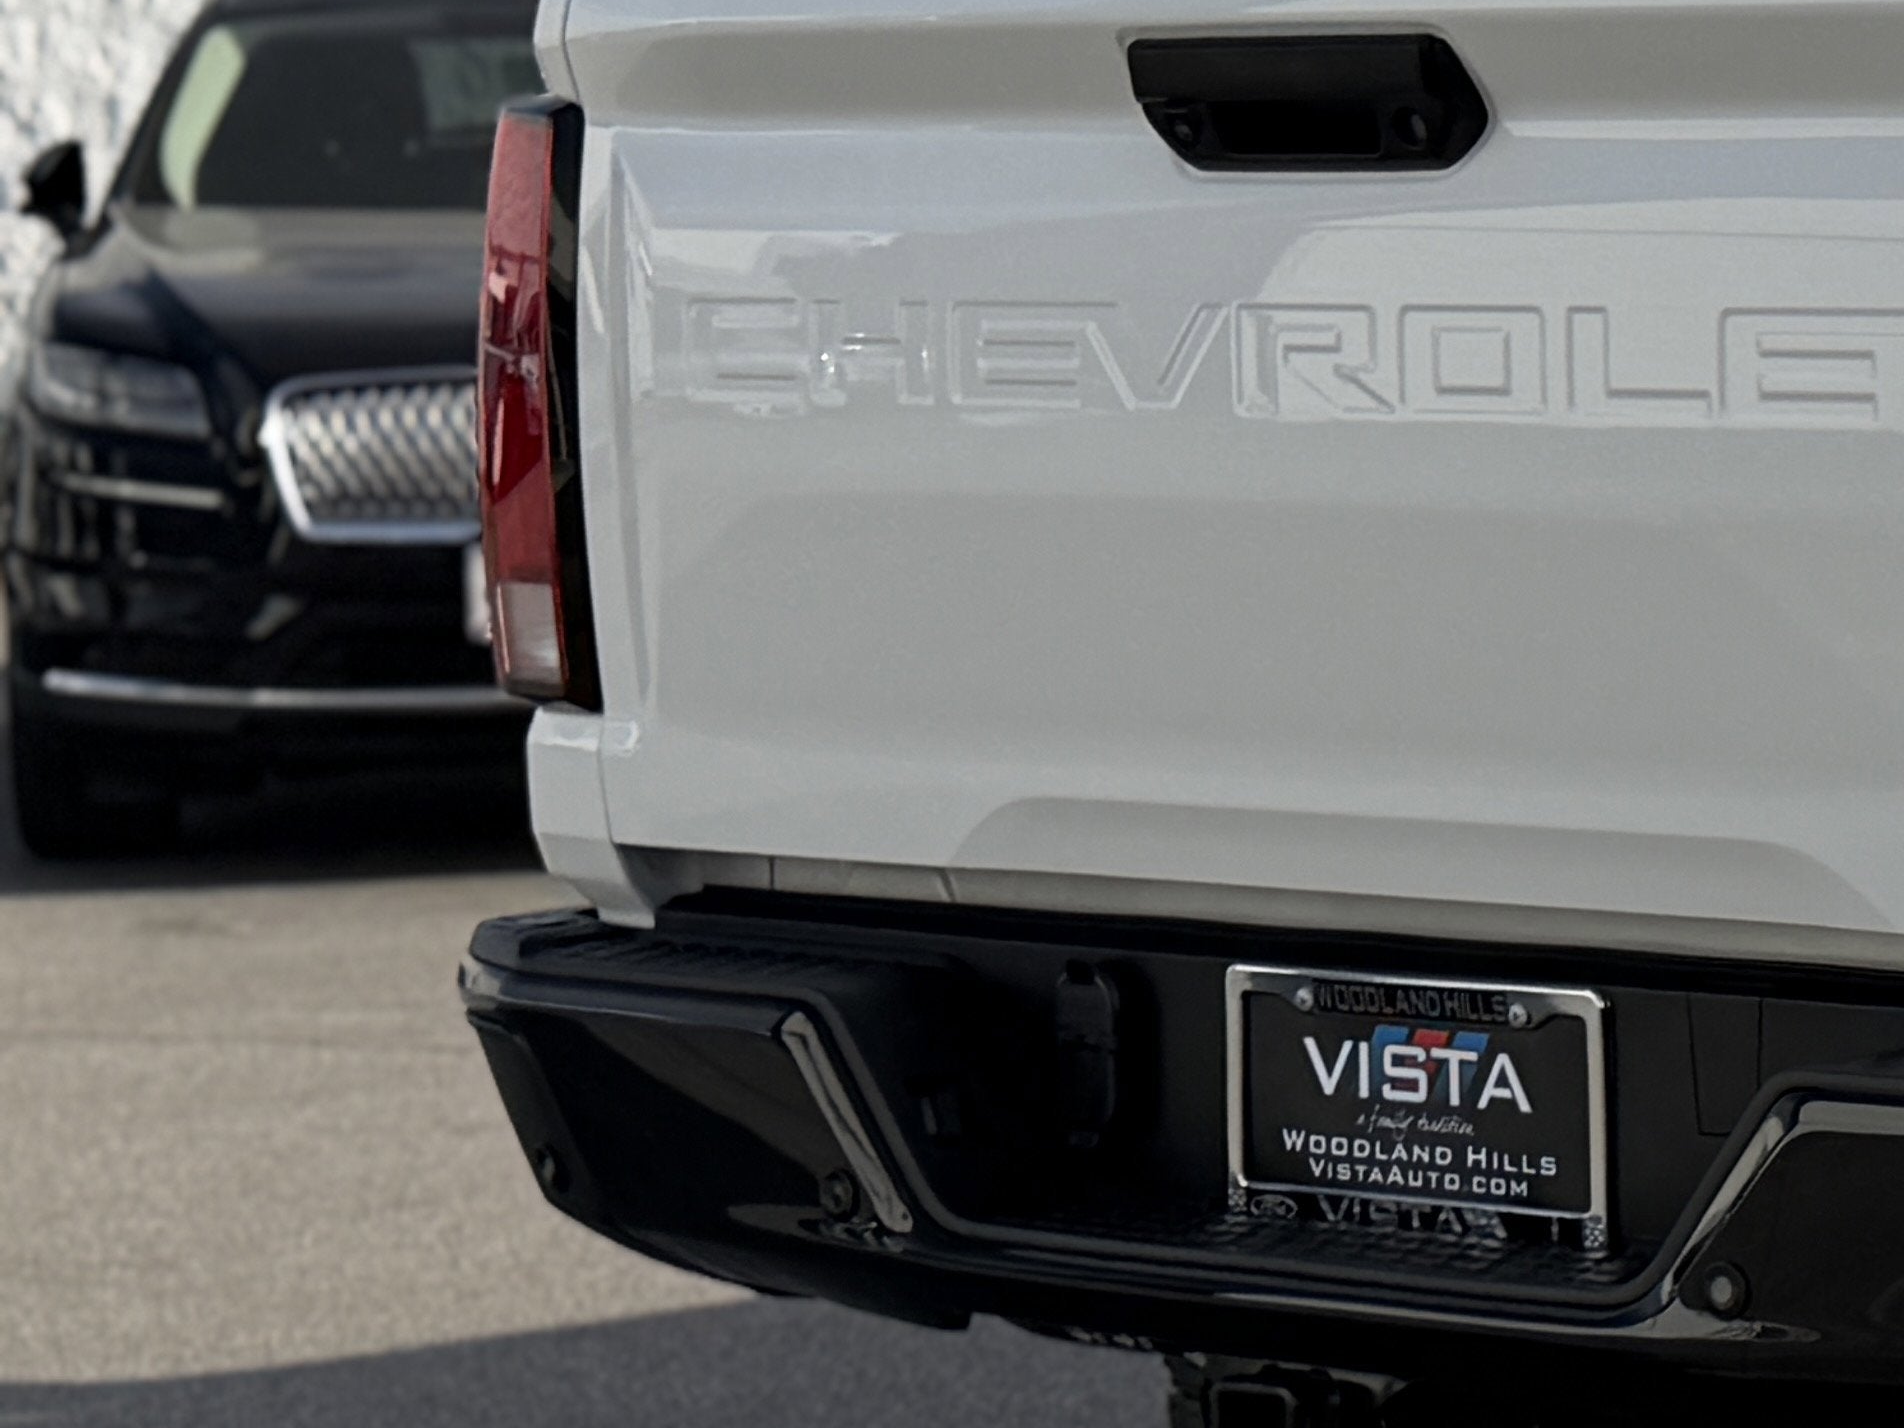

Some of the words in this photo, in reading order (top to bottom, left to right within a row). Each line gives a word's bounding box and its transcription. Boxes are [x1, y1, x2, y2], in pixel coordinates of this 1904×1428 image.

[1318, 984, 1442, 1018] WOODLAND
[1443, 989, 1509, 1022] HILLS
[1303, 1035, 1534, 1113] VISTA
[1282, 1127, 1453, 1166] WOODLAND
[1466, 1144, 1557, 1177] HILLS
